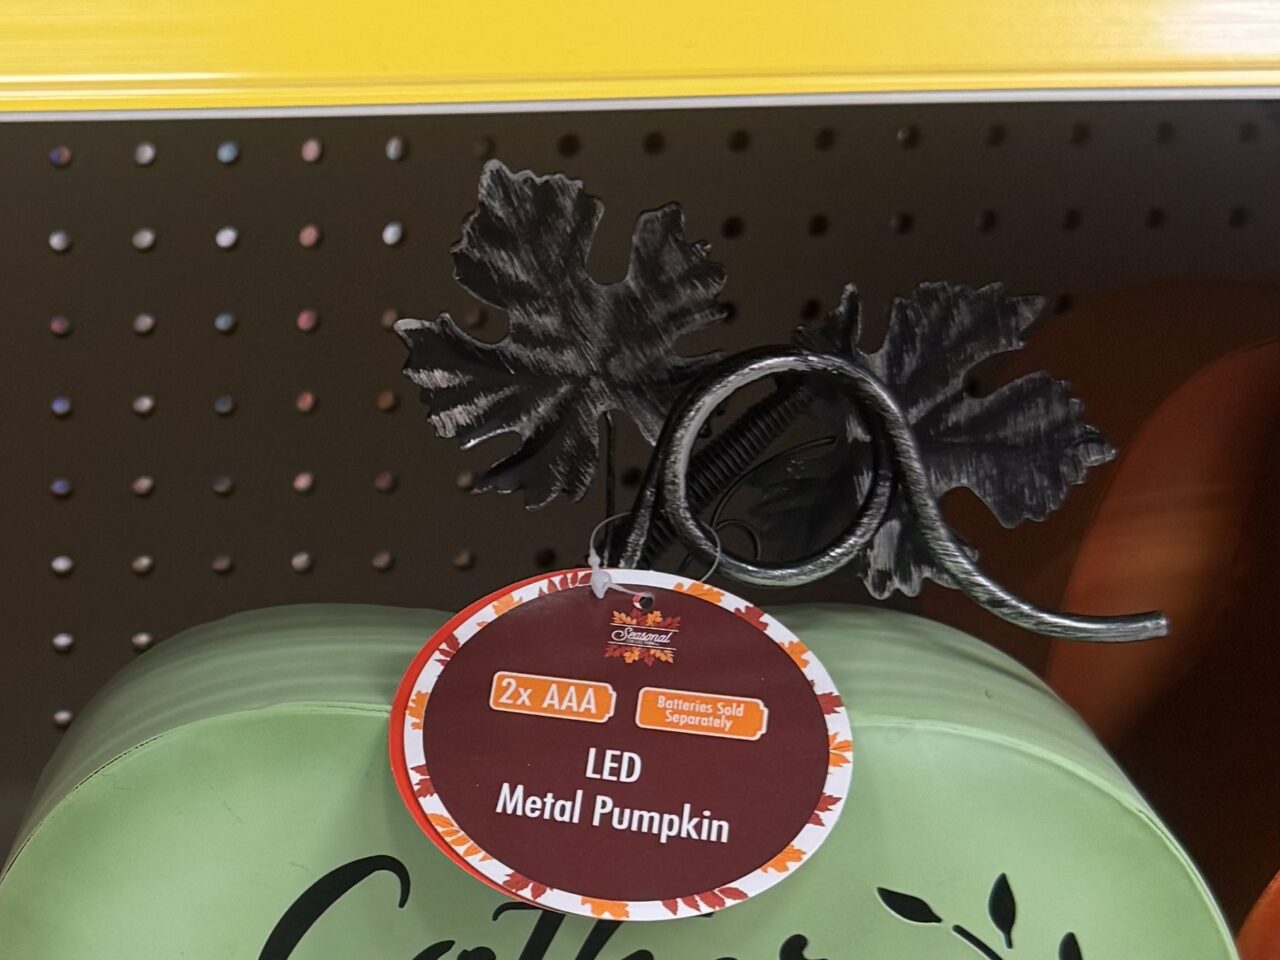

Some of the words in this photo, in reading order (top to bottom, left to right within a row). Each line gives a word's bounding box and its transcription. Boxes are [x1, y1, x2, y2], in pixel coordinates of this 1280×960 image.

[611, 626, 673, 643] Seasonal
[498, 677, 532, 706] 2x
[542, 683, 597, 714] AAA
[657, 695, 713, 714] Batteries
[717, 701, 745, 717] Sold
[665, 710, 733, 731] Separately
[585, 747, 642, 783] LED
[495, 782, 583, 824] Metal
[592, 794, 730, 844] Pumpkin
